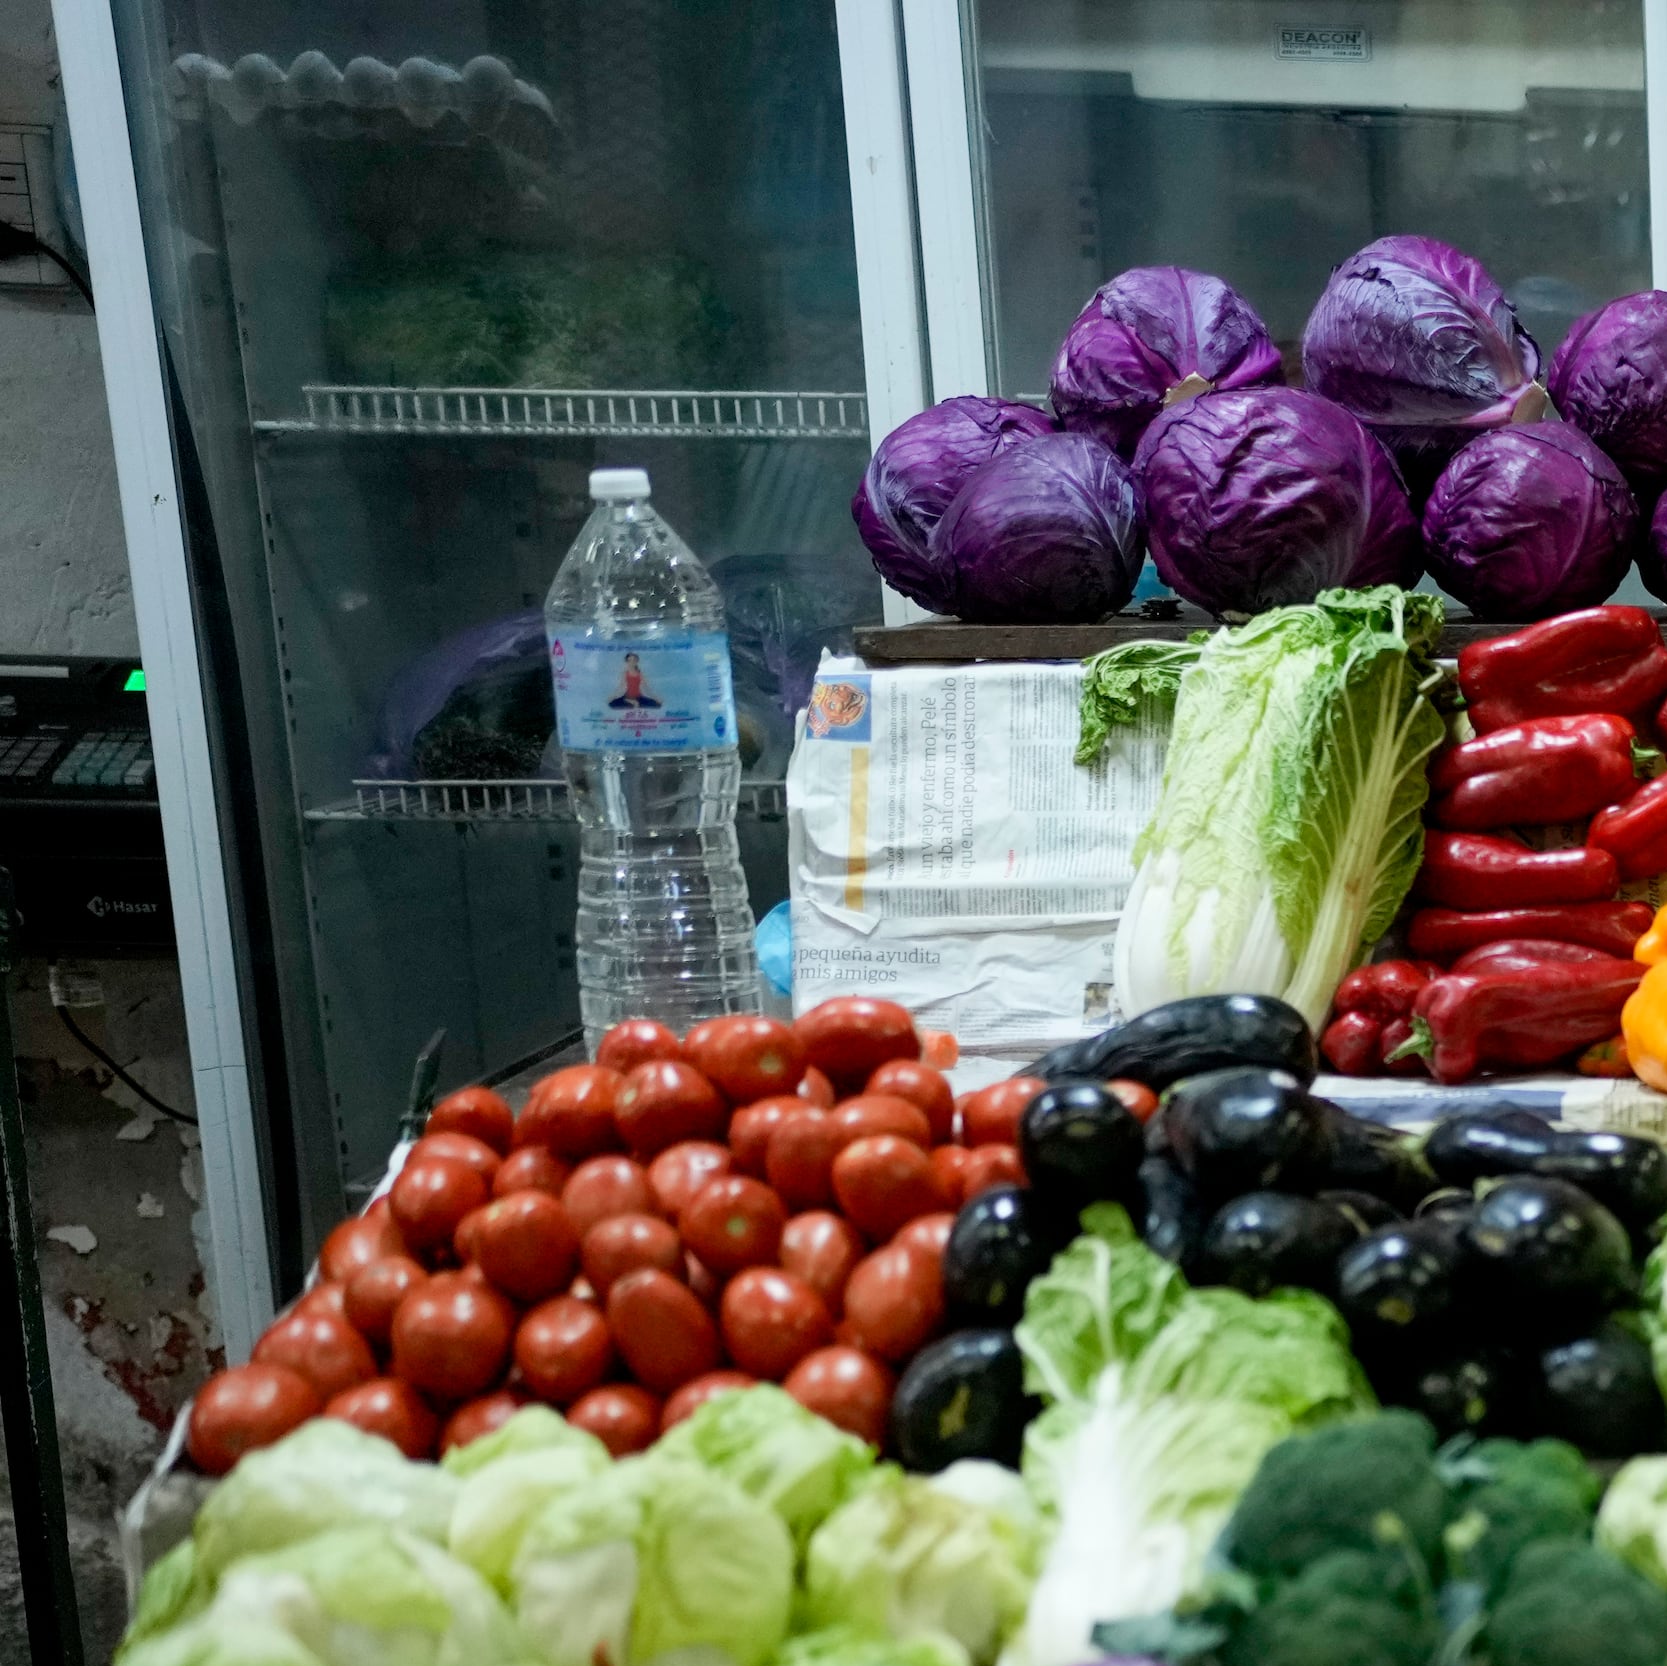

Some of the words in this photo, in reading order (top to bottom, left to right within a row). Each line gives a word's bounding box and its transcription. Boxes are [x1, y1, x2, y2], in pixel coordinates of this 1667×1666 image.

[1282, 32, 1357, 44] DEACON
[920, 697, 937, 730] Pelé
[940, 677, 957, 740] símbolo
[961, 675, 976, 750] destronar
[920, 733, 938, 800] enfermo,
[944, 744, 957, 763] un
[942, 767, 956, 807] como
[959, 753, 978, 793] podía
[922, 803, 941, 812] y
[938, 808, 954, 834] ahí
[958, 796, 974, 837] nadie
[919, 814, 936, 851] viejo
[961, 840, 976, 870] que
[113, 901, 159, 913] Hasar
[799, 946, 873, 964] pequeña
[875, 947, 942, 966] ayudita
[800, 964, 831, 980] mis
[834, 966, 898, 984] amigos
